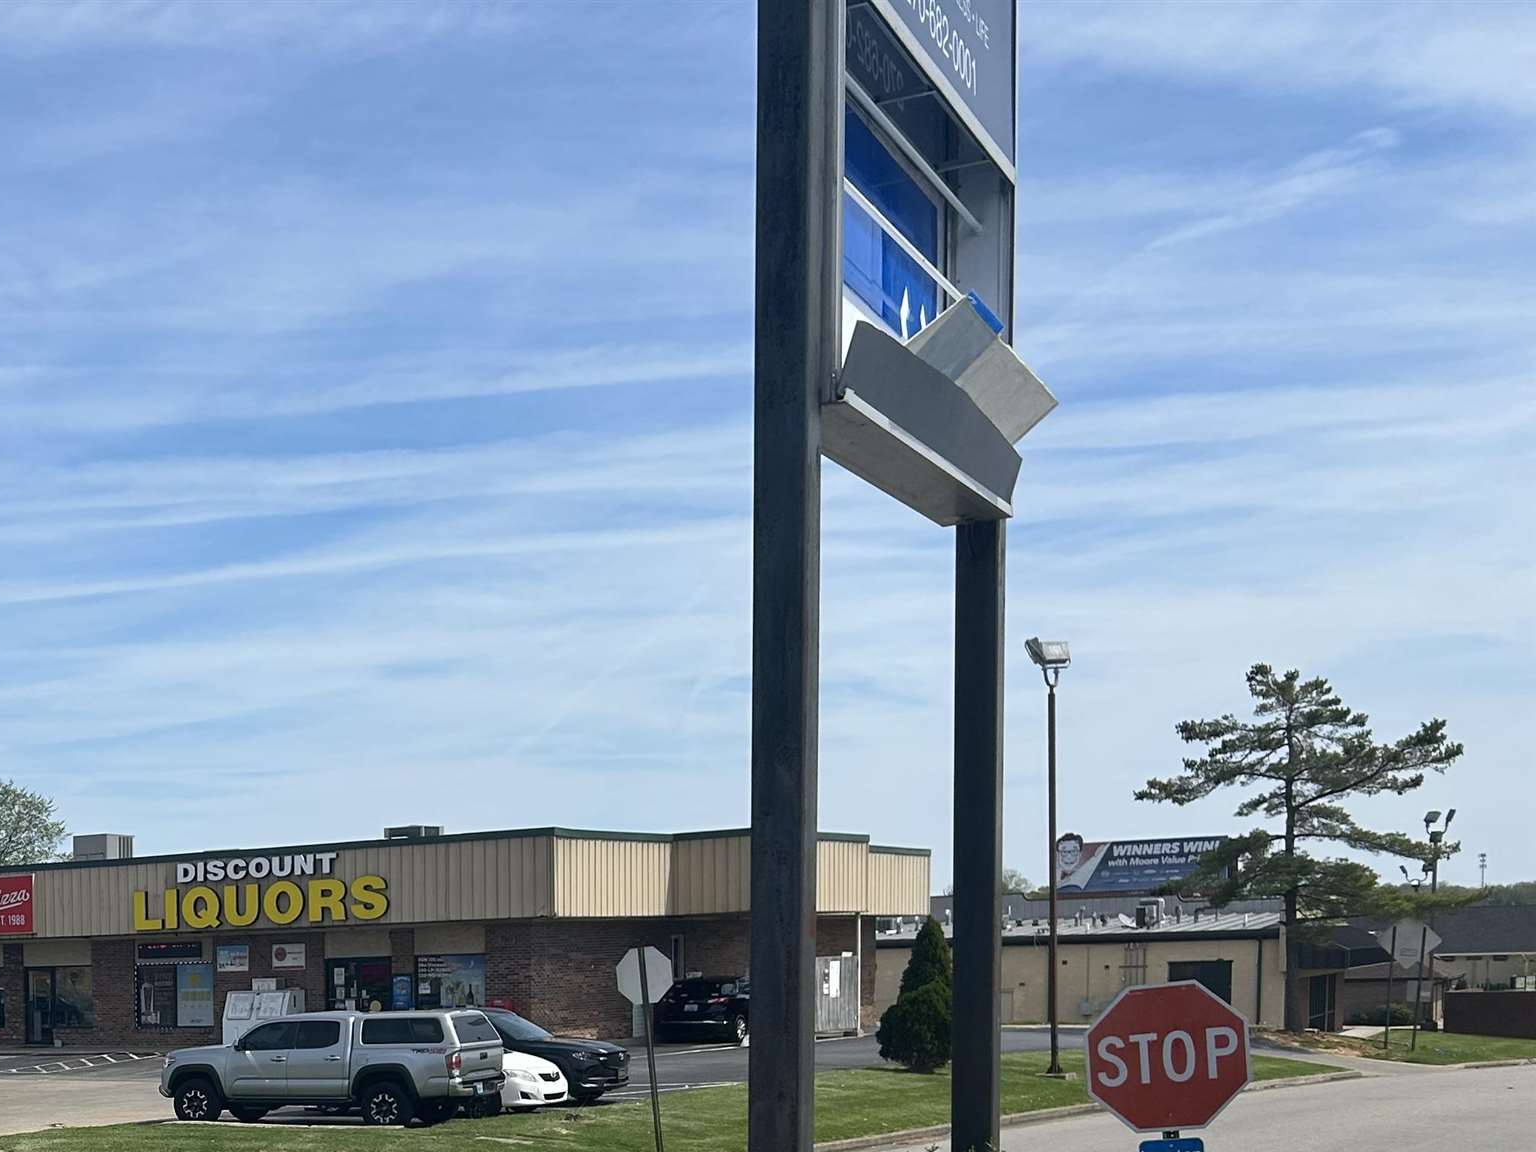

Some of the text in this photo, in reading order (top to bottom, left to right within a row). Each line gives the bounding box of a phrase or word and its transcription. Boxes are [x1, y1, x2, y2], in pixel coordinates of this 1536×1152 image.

[907, 0, 977, 96] 0-682-0001
[176, 852, 338, 883] DISCOUNT
[1107, 859, 1128, 868] with
[1129, 857, 1159, 867] Moore
[1161, 855, 1185, 865] Value
[1113, 842, 1181, 856] WINNERS
[133, 875, 389, 931] LIQUORS
[1097, 1026, 1238, 1088] STOP
